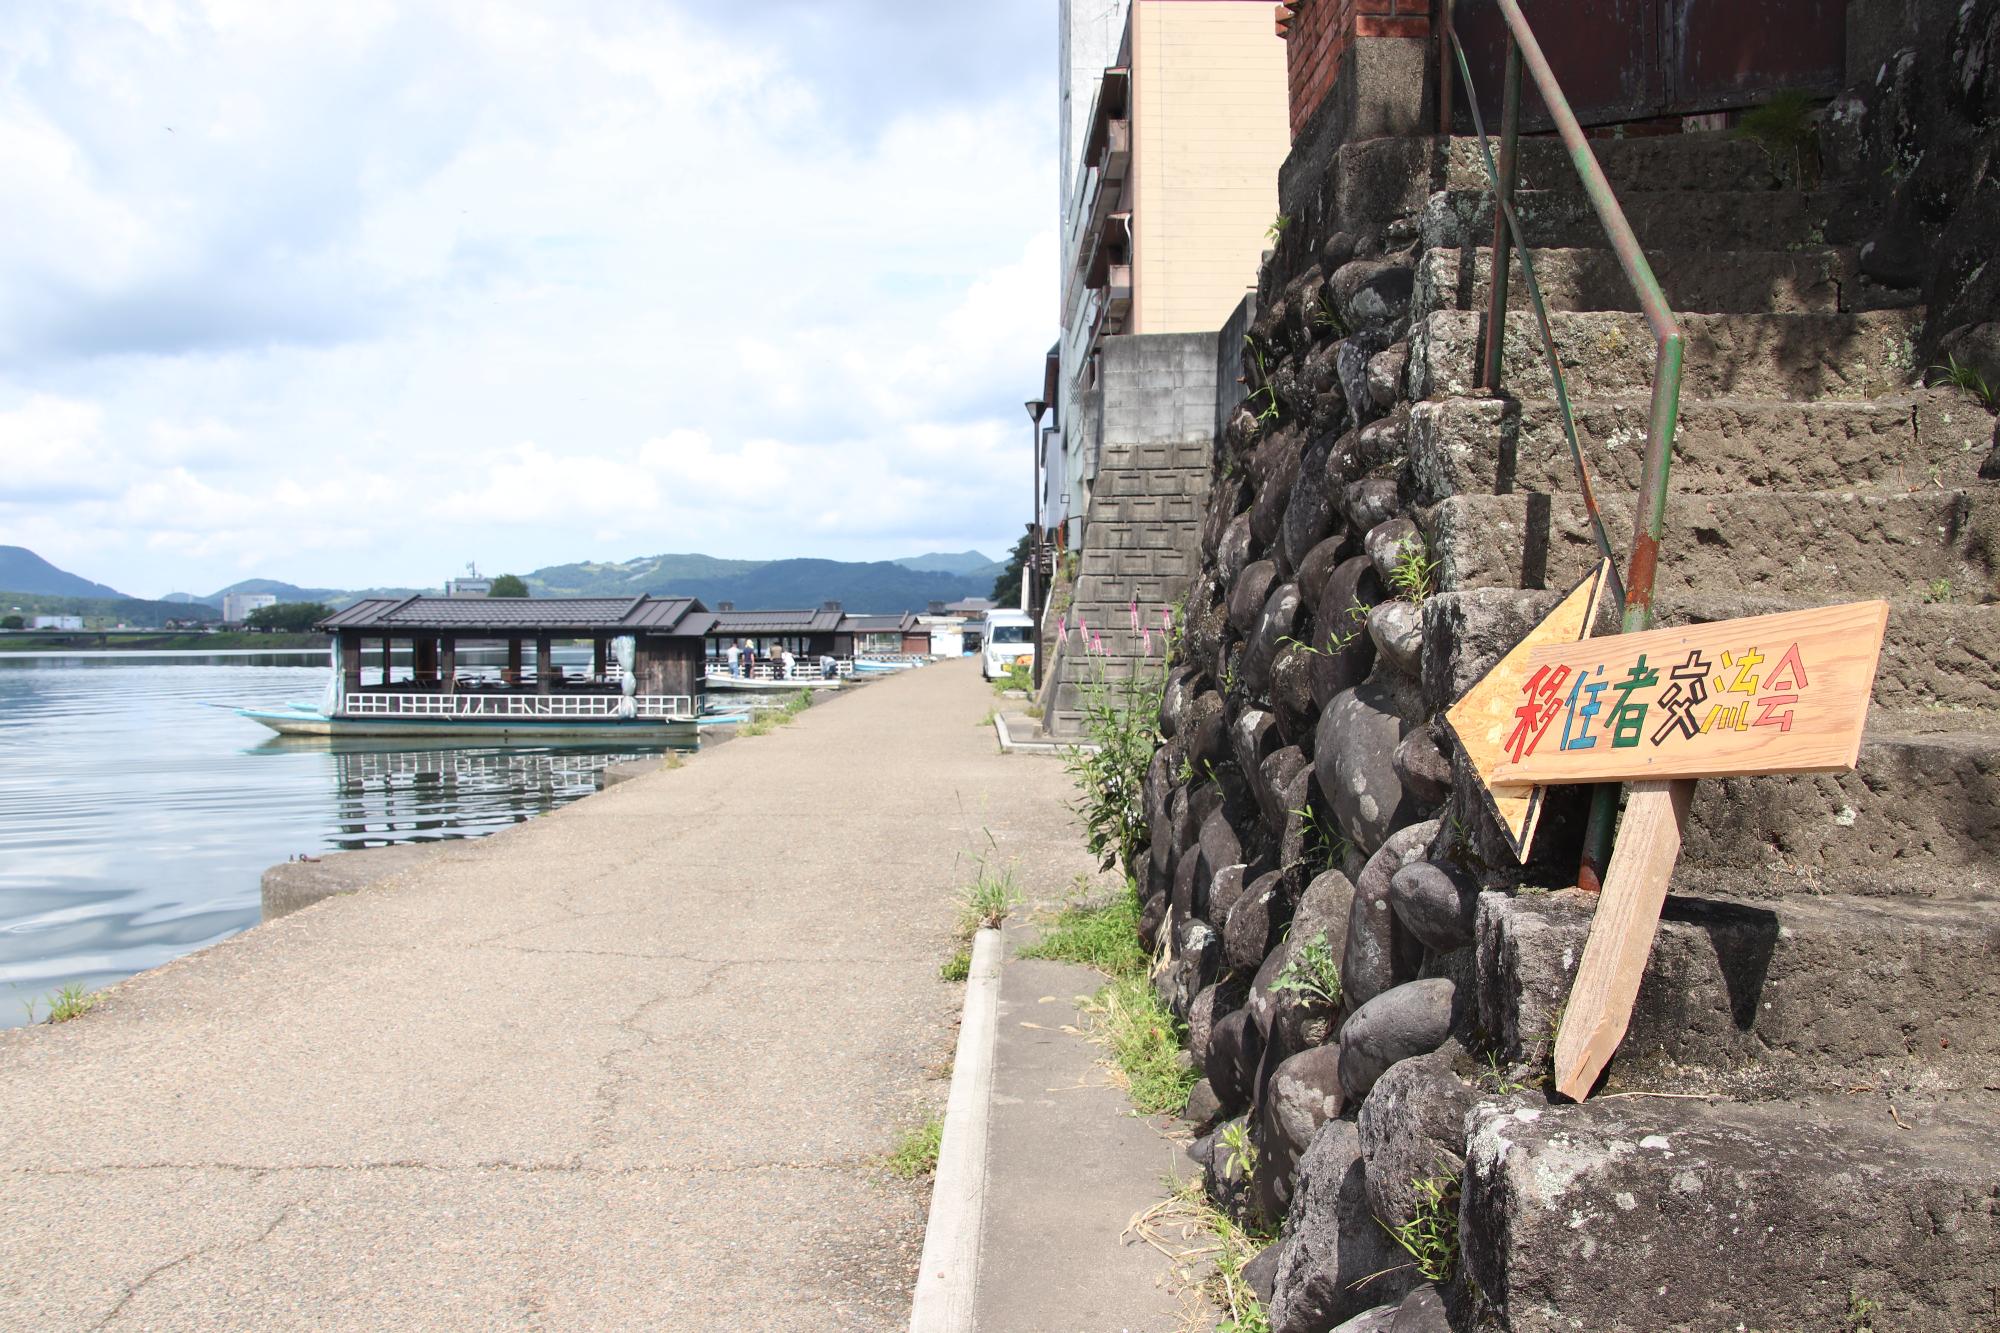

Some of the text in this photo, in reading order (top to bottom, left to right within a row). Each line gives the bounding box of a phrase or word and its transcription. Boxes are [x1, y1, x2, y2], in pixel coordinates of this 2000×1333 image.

[1504, 643, 1808, 763] 移住者交流会
